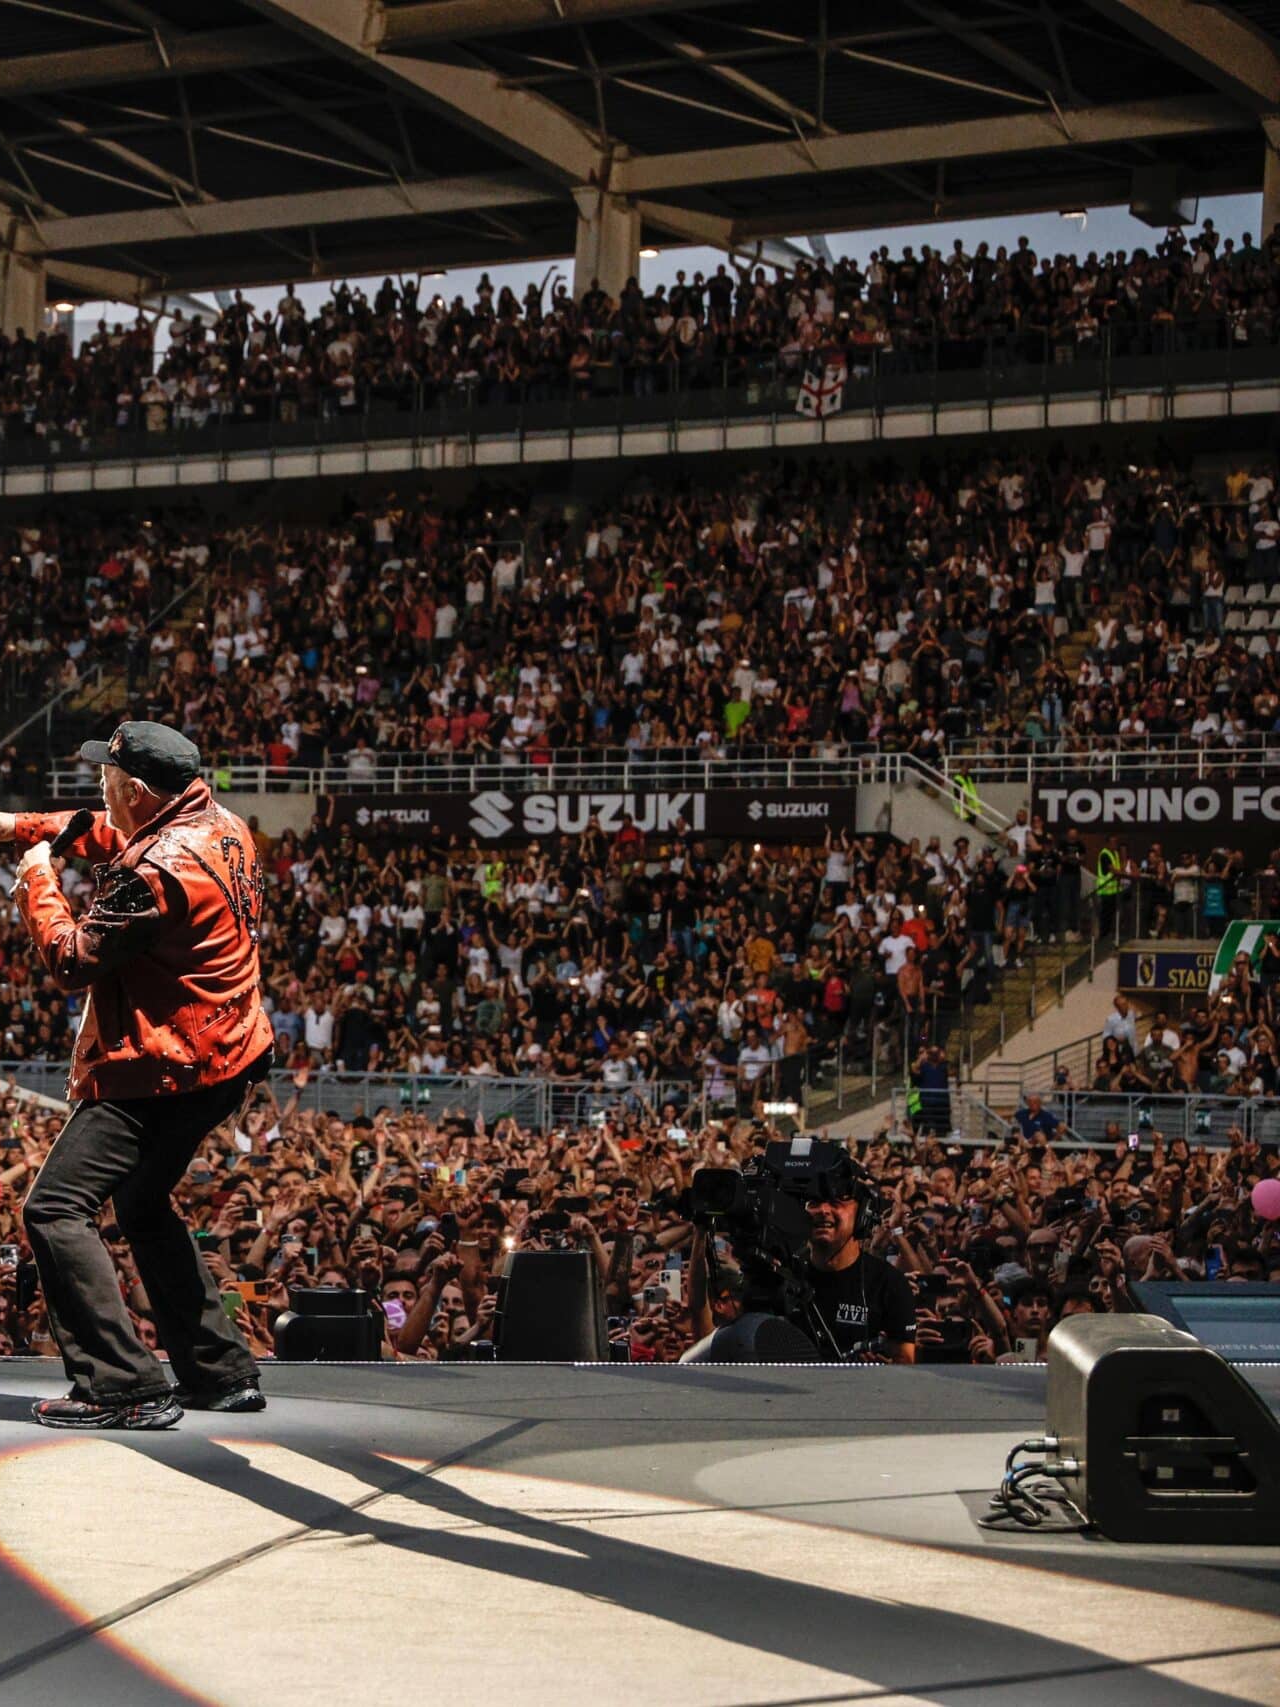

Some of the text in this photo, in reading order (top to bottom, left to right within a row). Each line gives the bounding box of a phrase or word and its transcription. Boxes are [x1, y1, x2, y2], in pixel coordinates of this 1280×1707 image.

[765, 802, 830, 818] SUZUKI
[1038, 786, 1221, 823] TORINO
[371, 808, 431, 823] SZUKI
[522, 792, 707, 834] SUZUKI
[1168, 968, 1209, 988] STAD
[784, 1160, 812, 1168] SONY
[836, 1310, 869, 1322] LIVE
